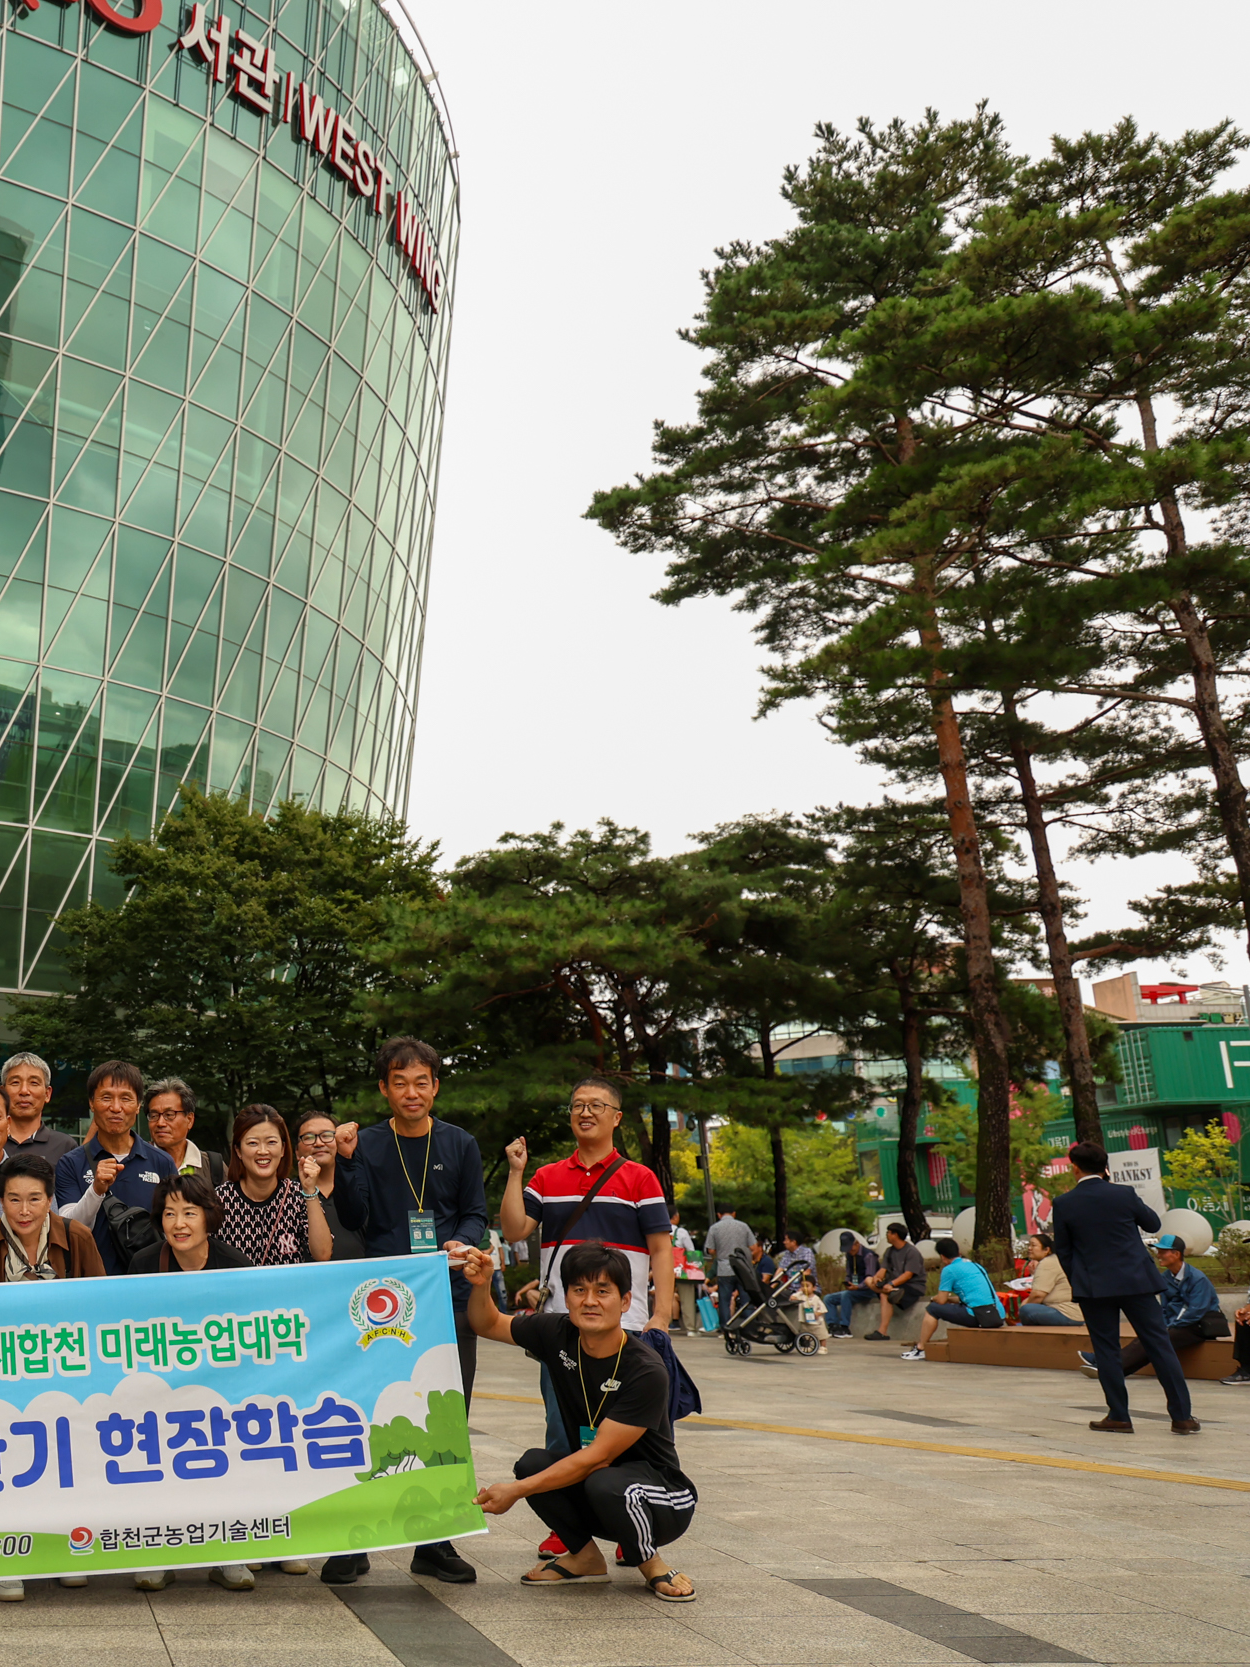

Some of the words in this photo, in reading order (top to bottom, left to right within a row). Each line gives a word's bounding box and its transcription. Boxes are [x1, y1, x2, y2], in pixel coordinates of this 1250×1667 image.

[179, 2, 280, 115] 서관
[298, 81, 393, 216] WEST
[395, 190, 442, 315] WING
[1113, 1168, 1152, 1182] BANKSY
[101, 1313, 306, 1369] 미래농업대학
[95, 1396, 366, 1486] 현장학습
[99, 1515, 291, 1552] 합천군농업기술센터
